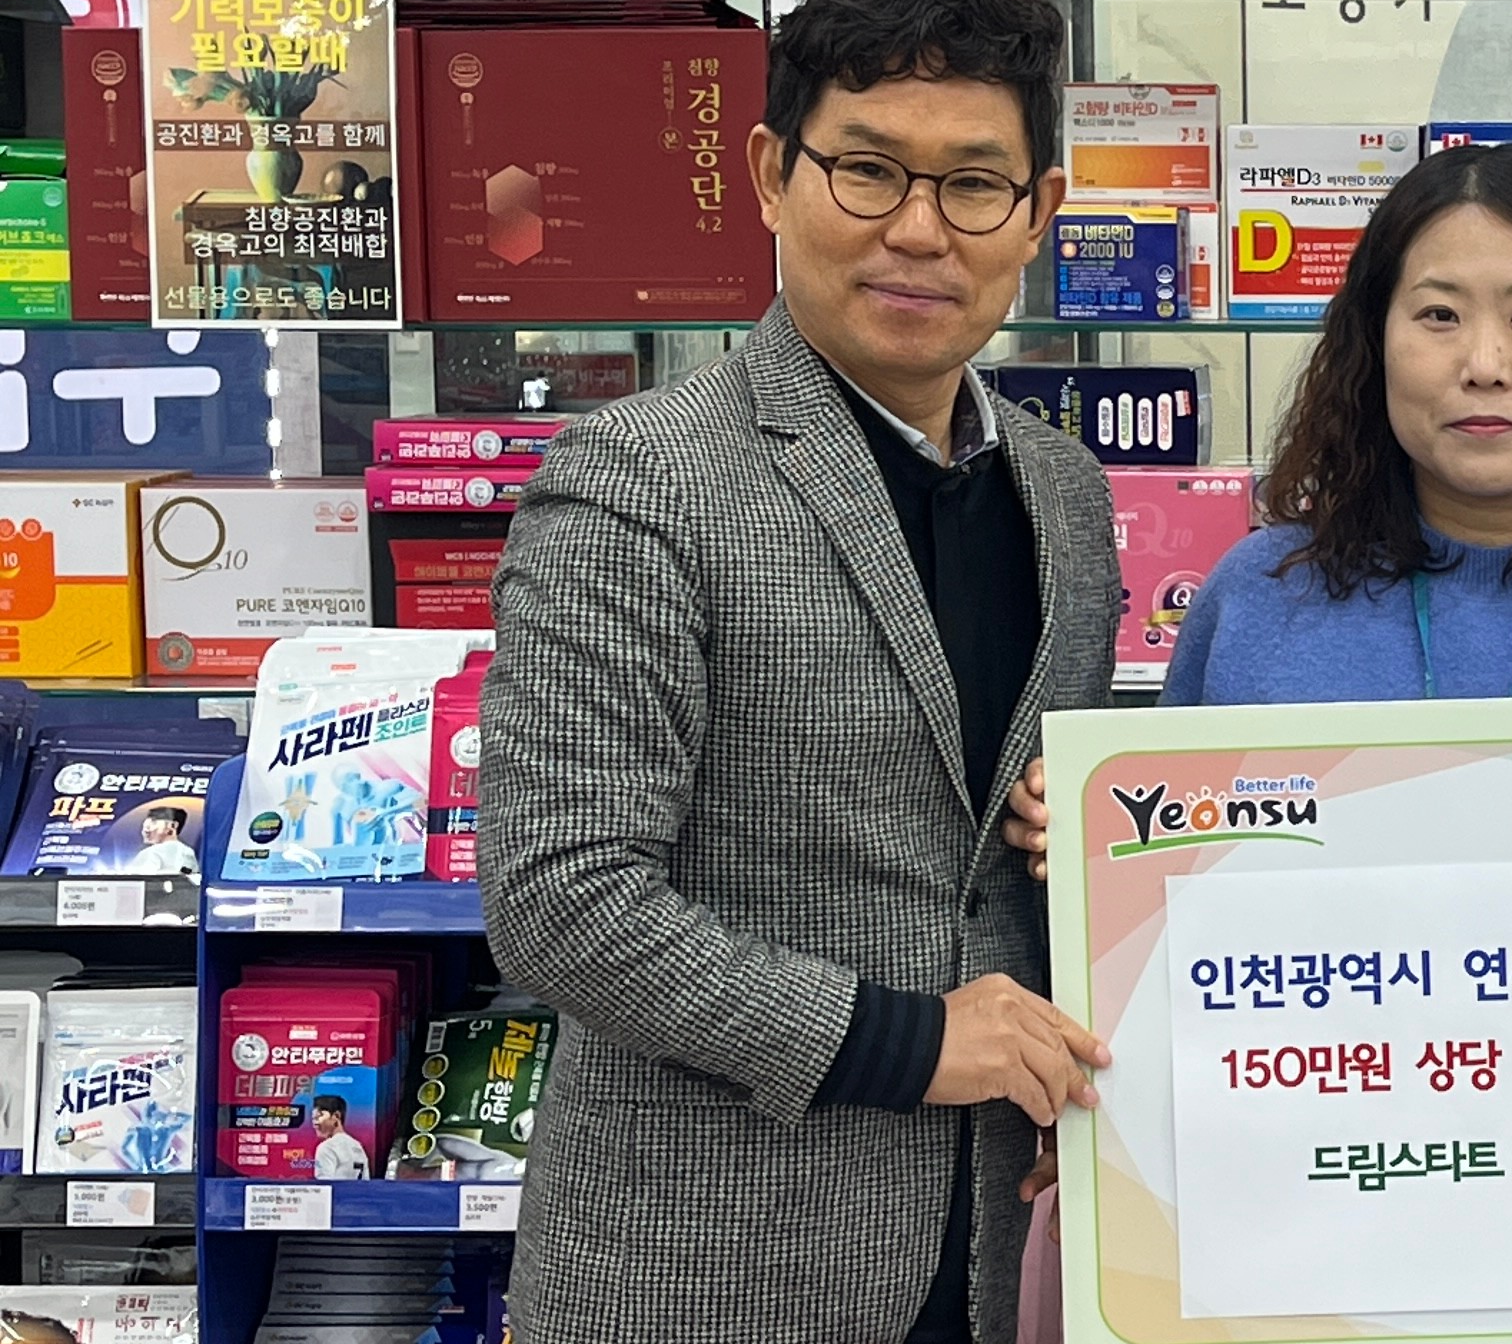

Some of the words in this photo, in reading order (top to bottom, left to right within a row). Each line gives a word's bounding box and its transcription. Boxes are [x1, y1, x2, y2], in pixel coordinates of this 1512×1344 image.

[157, 123, 243, 147] 공진환과
[251, 123, 336, 147] 경옥고를
[343, 123, 386, 147] 함께
[687, 83, 726, 210] 경공단
[1240, 167, 1322, 187] 라파엘D3
[245, 208, 387, 232] 침향공진환과
[192, 233, 284, 257] 경옥고의
[294, 233, 387, 258] 최적배합
[1079, 243, 1116, 258] 2000
[1238, 208, 1293, 273] D
[164, 287, 297, 311] 선물용으로도
[304, 287, 391, 311] 좋습니다
[236, 599, 277, 613] PURE
[282, 598, 366, 615] 코엔자임Q10
[268, 713, 372, 772] 사라펜
[1235, 778, 1285, 793] Better
[1289, 776, 1316, 791] life
[1111, 782, 1317, 846] Yeonsu
[1190, 949, 1432, 1011] 인천광역시
[271, 1046, 363, 1066] 안티푸라민
[1221, 1041, 1393, 1094] 150만원
[1415, 1038, 1503, 1093] 상당
[1307, 1140, 1506, 1192] 드림스타트
